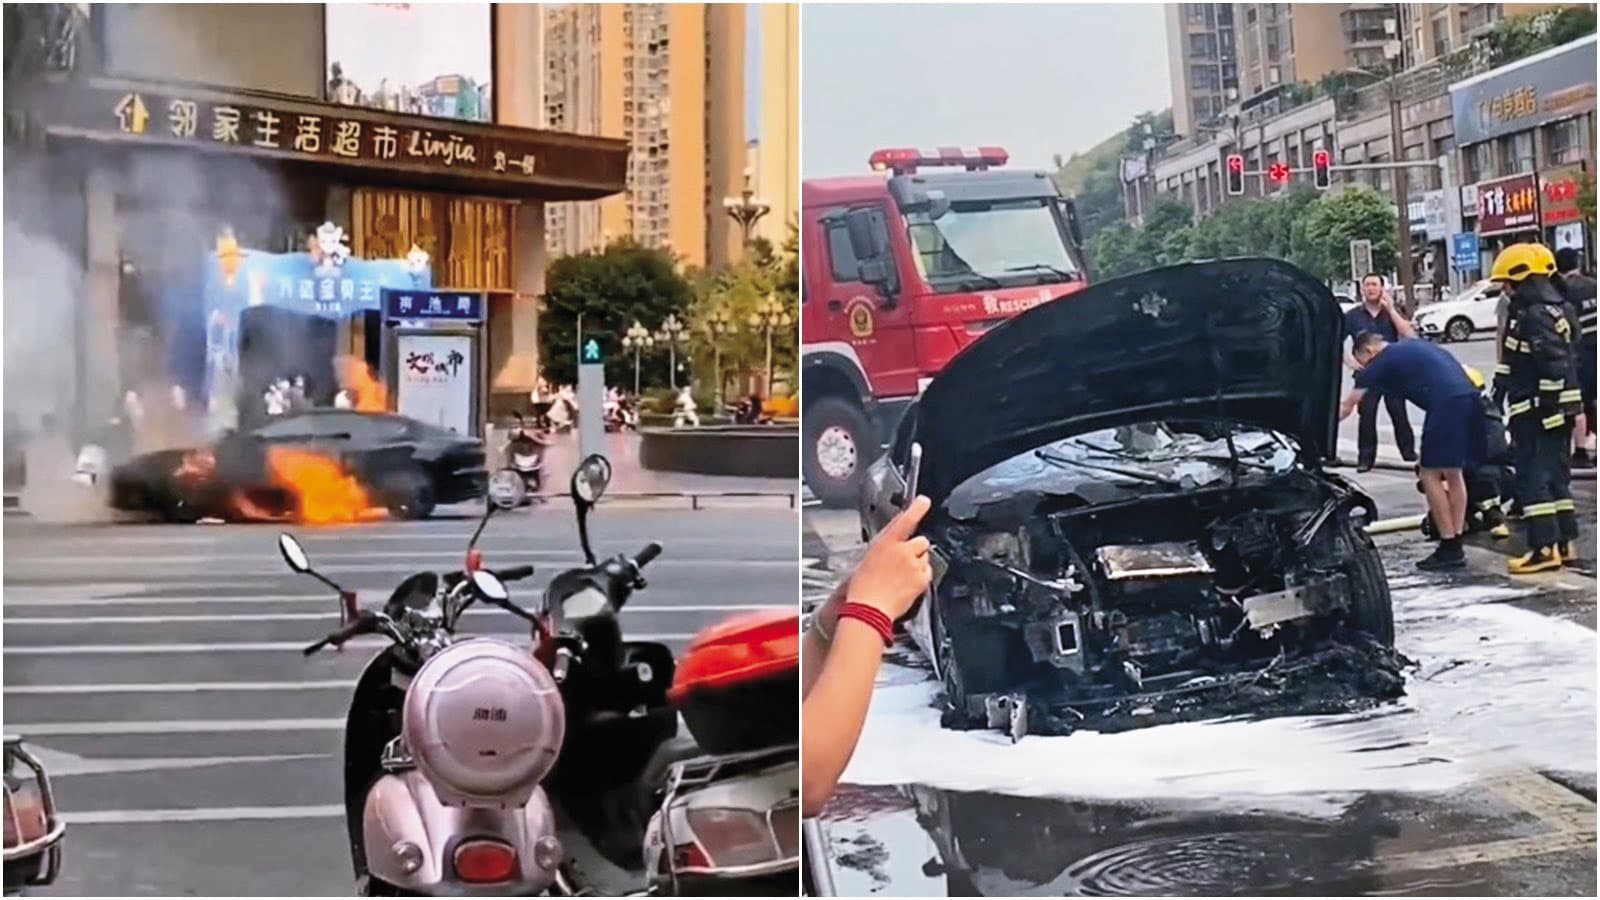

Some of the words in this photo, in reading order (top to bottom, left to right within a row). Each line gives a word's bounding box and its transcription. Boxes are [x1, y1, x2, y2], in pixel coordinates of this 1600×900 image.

[168, 99, 398, 160] 邻家生活超市
[407, 130, 476, 165] Linjia
[1269, 163, 1289, 181] 25
